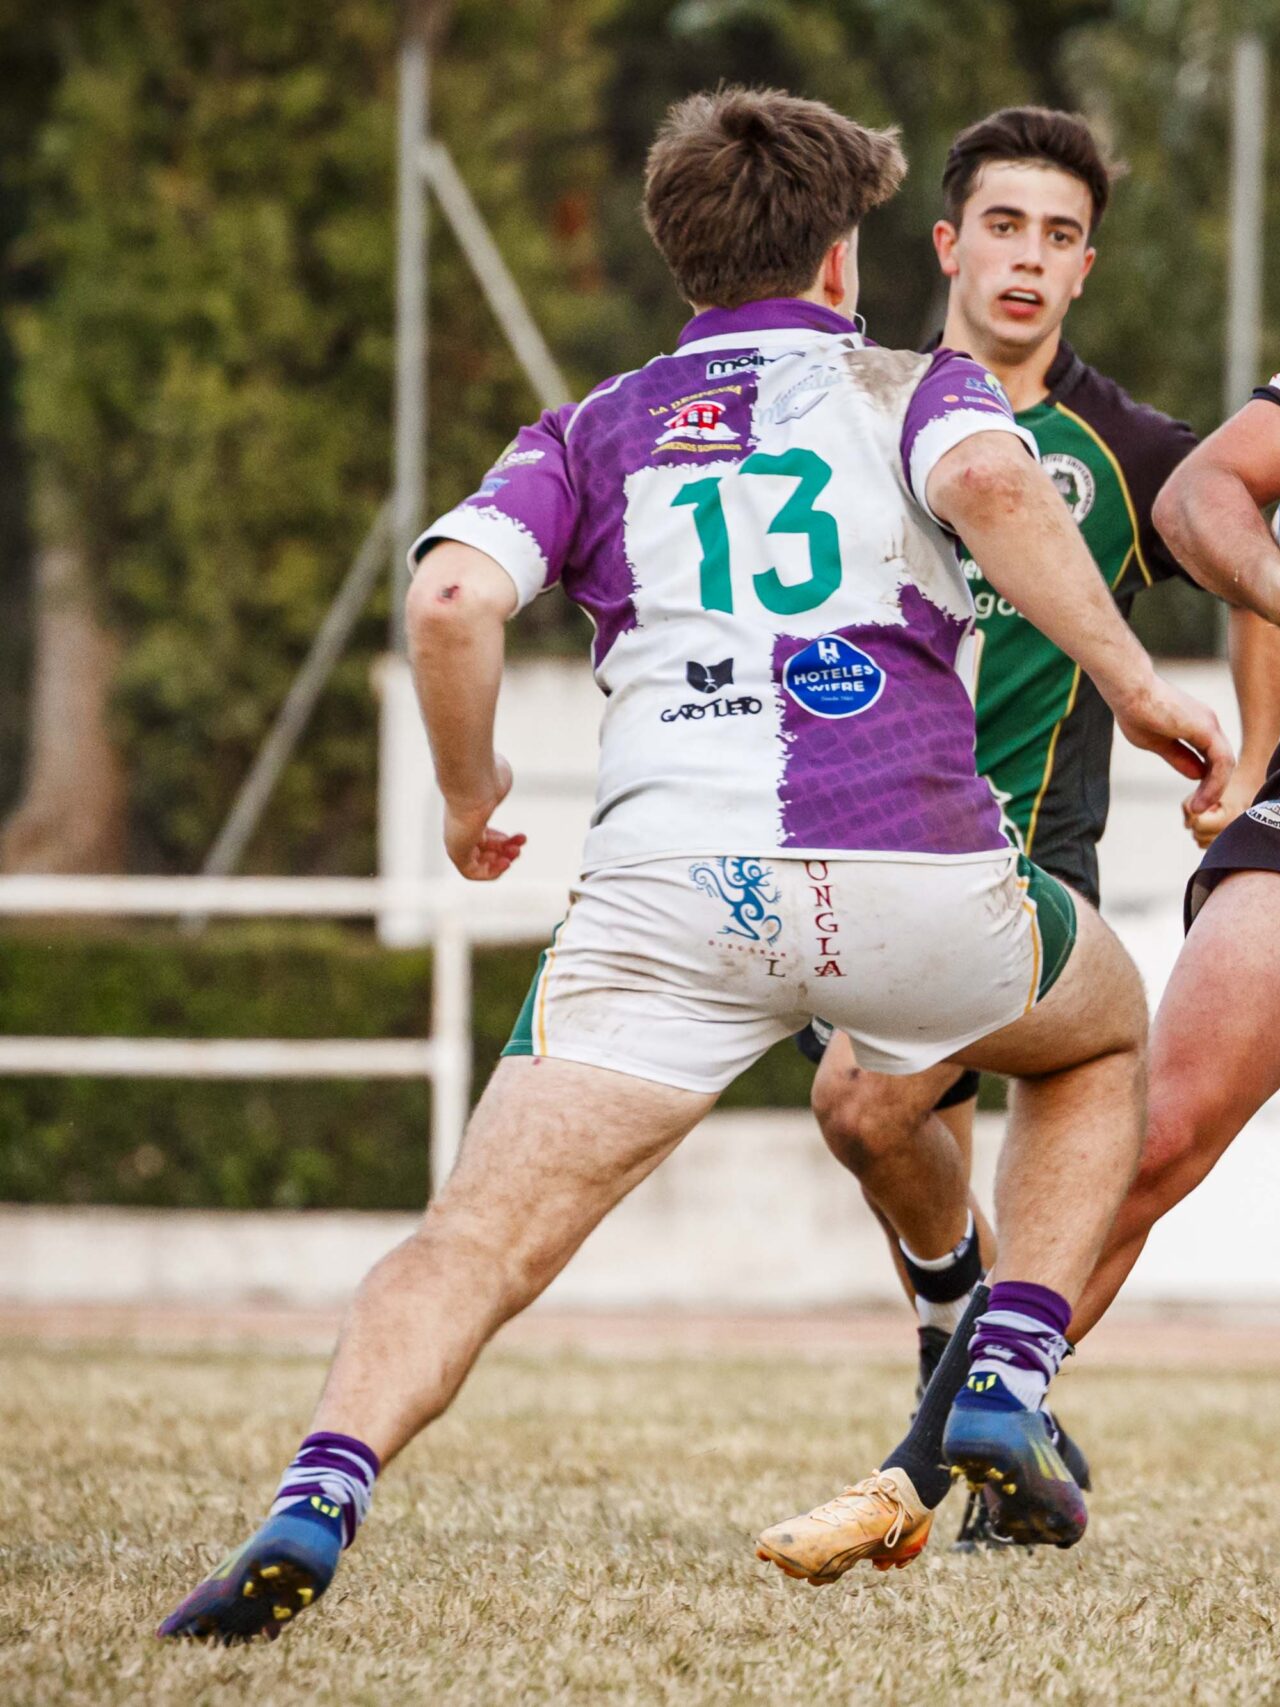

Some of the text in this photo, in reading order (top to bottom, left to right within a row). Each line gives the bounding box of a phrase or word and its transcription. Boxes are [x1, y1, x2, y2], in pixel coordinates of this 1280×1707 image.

[649, 406, 668, 416] LA
[670, 447, 843, 616] 13
[793, 664, 874, 686] HOTELES
[806, 680, 865, 692] WIFRE
